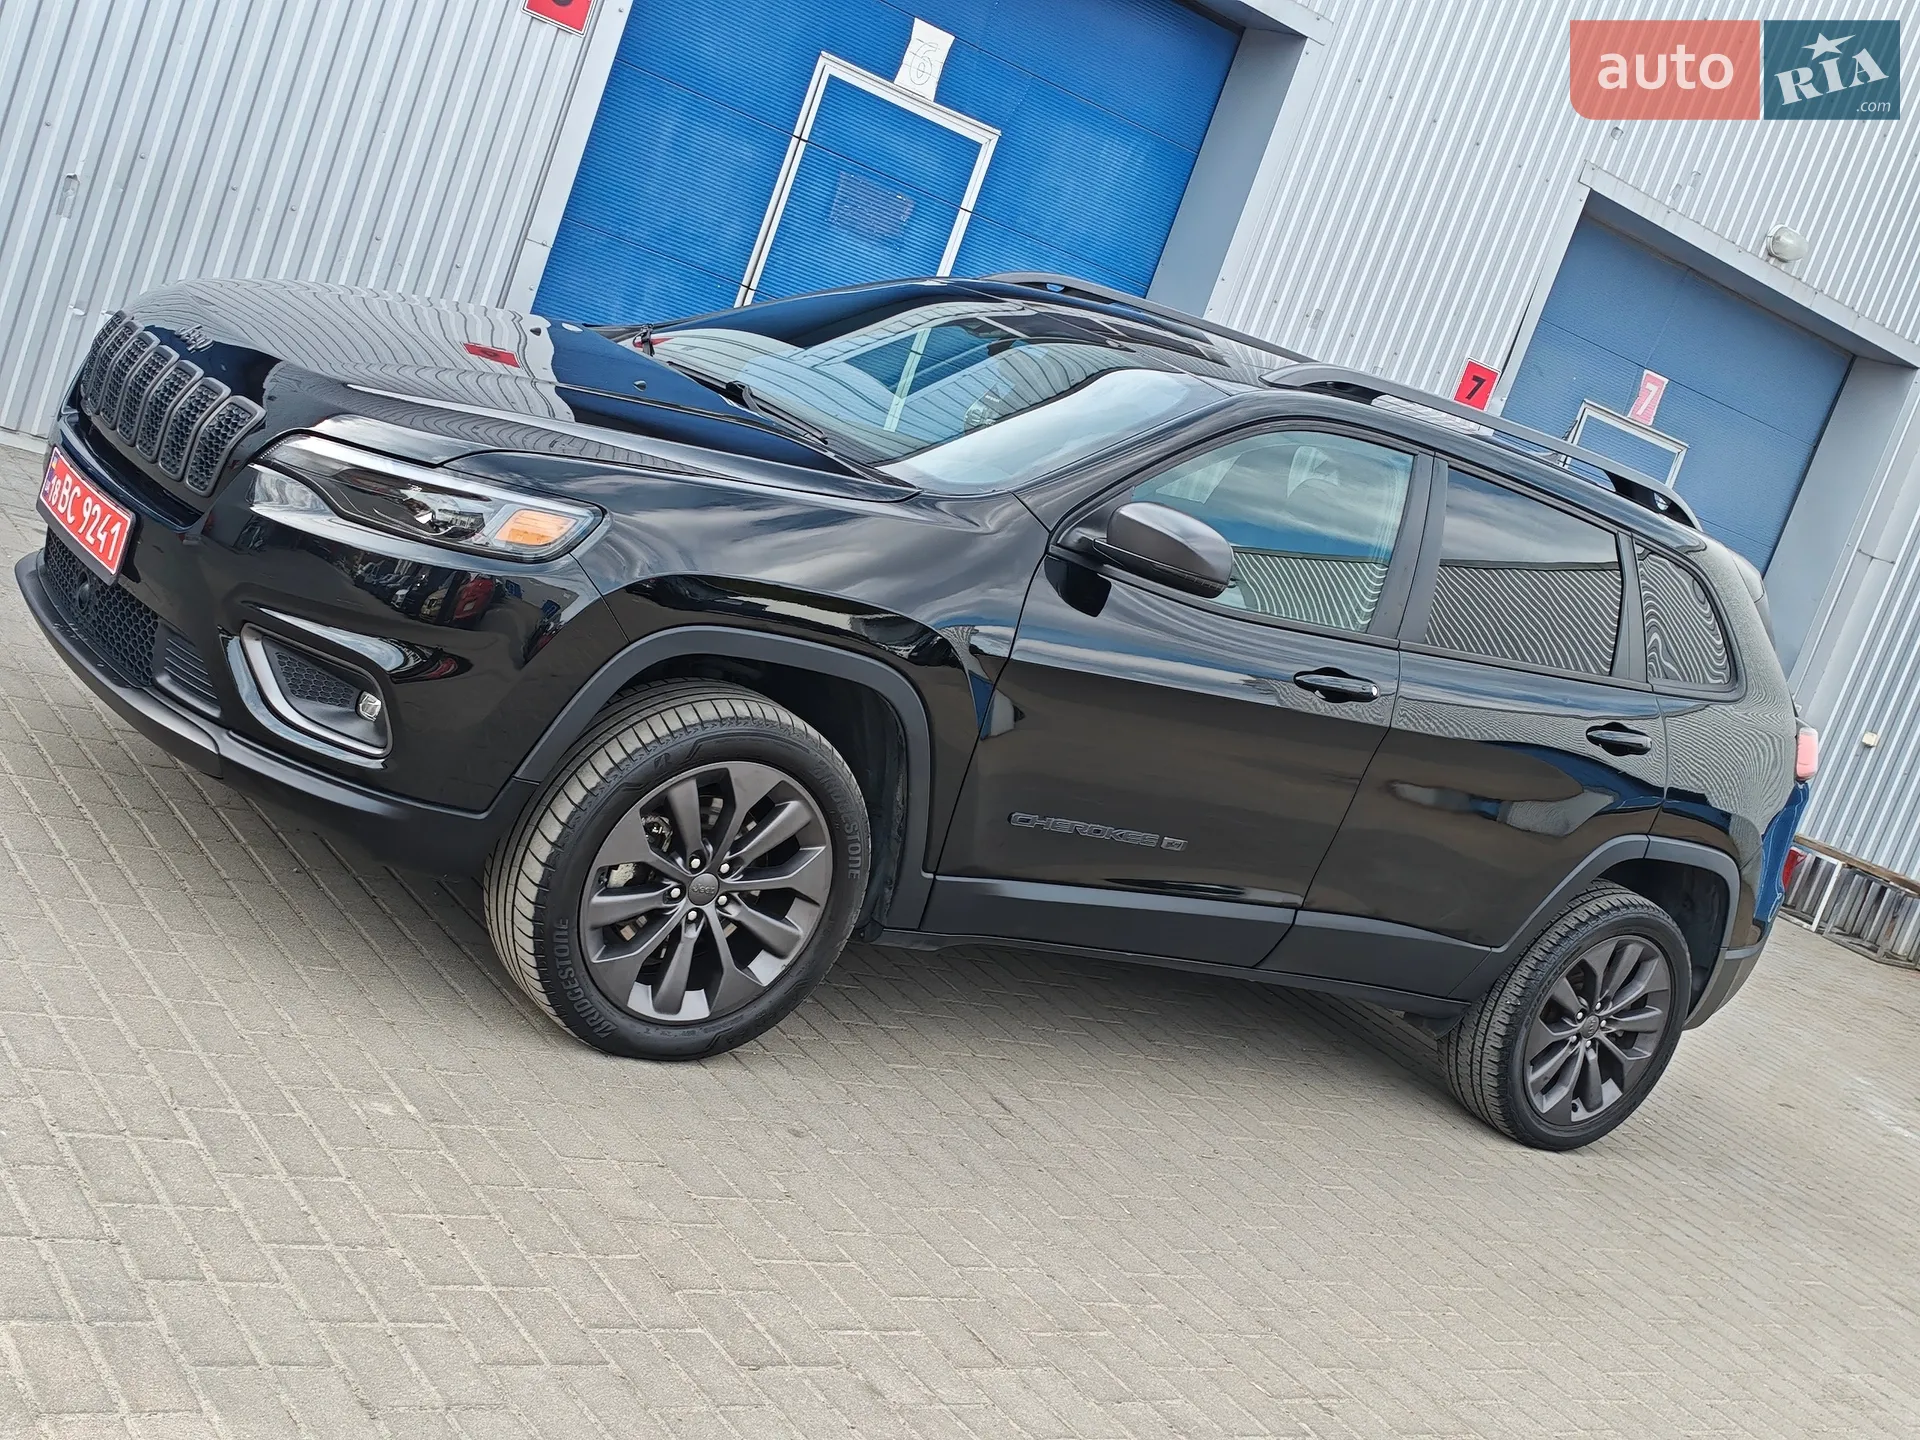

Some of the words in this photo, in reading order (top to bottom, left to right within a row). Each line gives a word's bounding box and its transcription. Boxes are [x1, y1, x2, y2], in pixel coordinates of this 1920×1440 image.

[1465, 375, 1486, 400] 7
[1636, 382, 1658, 416] 7
[78, 497, 122, 561] 9241
[1010, 811, 1160, 848] CHEROKEE
